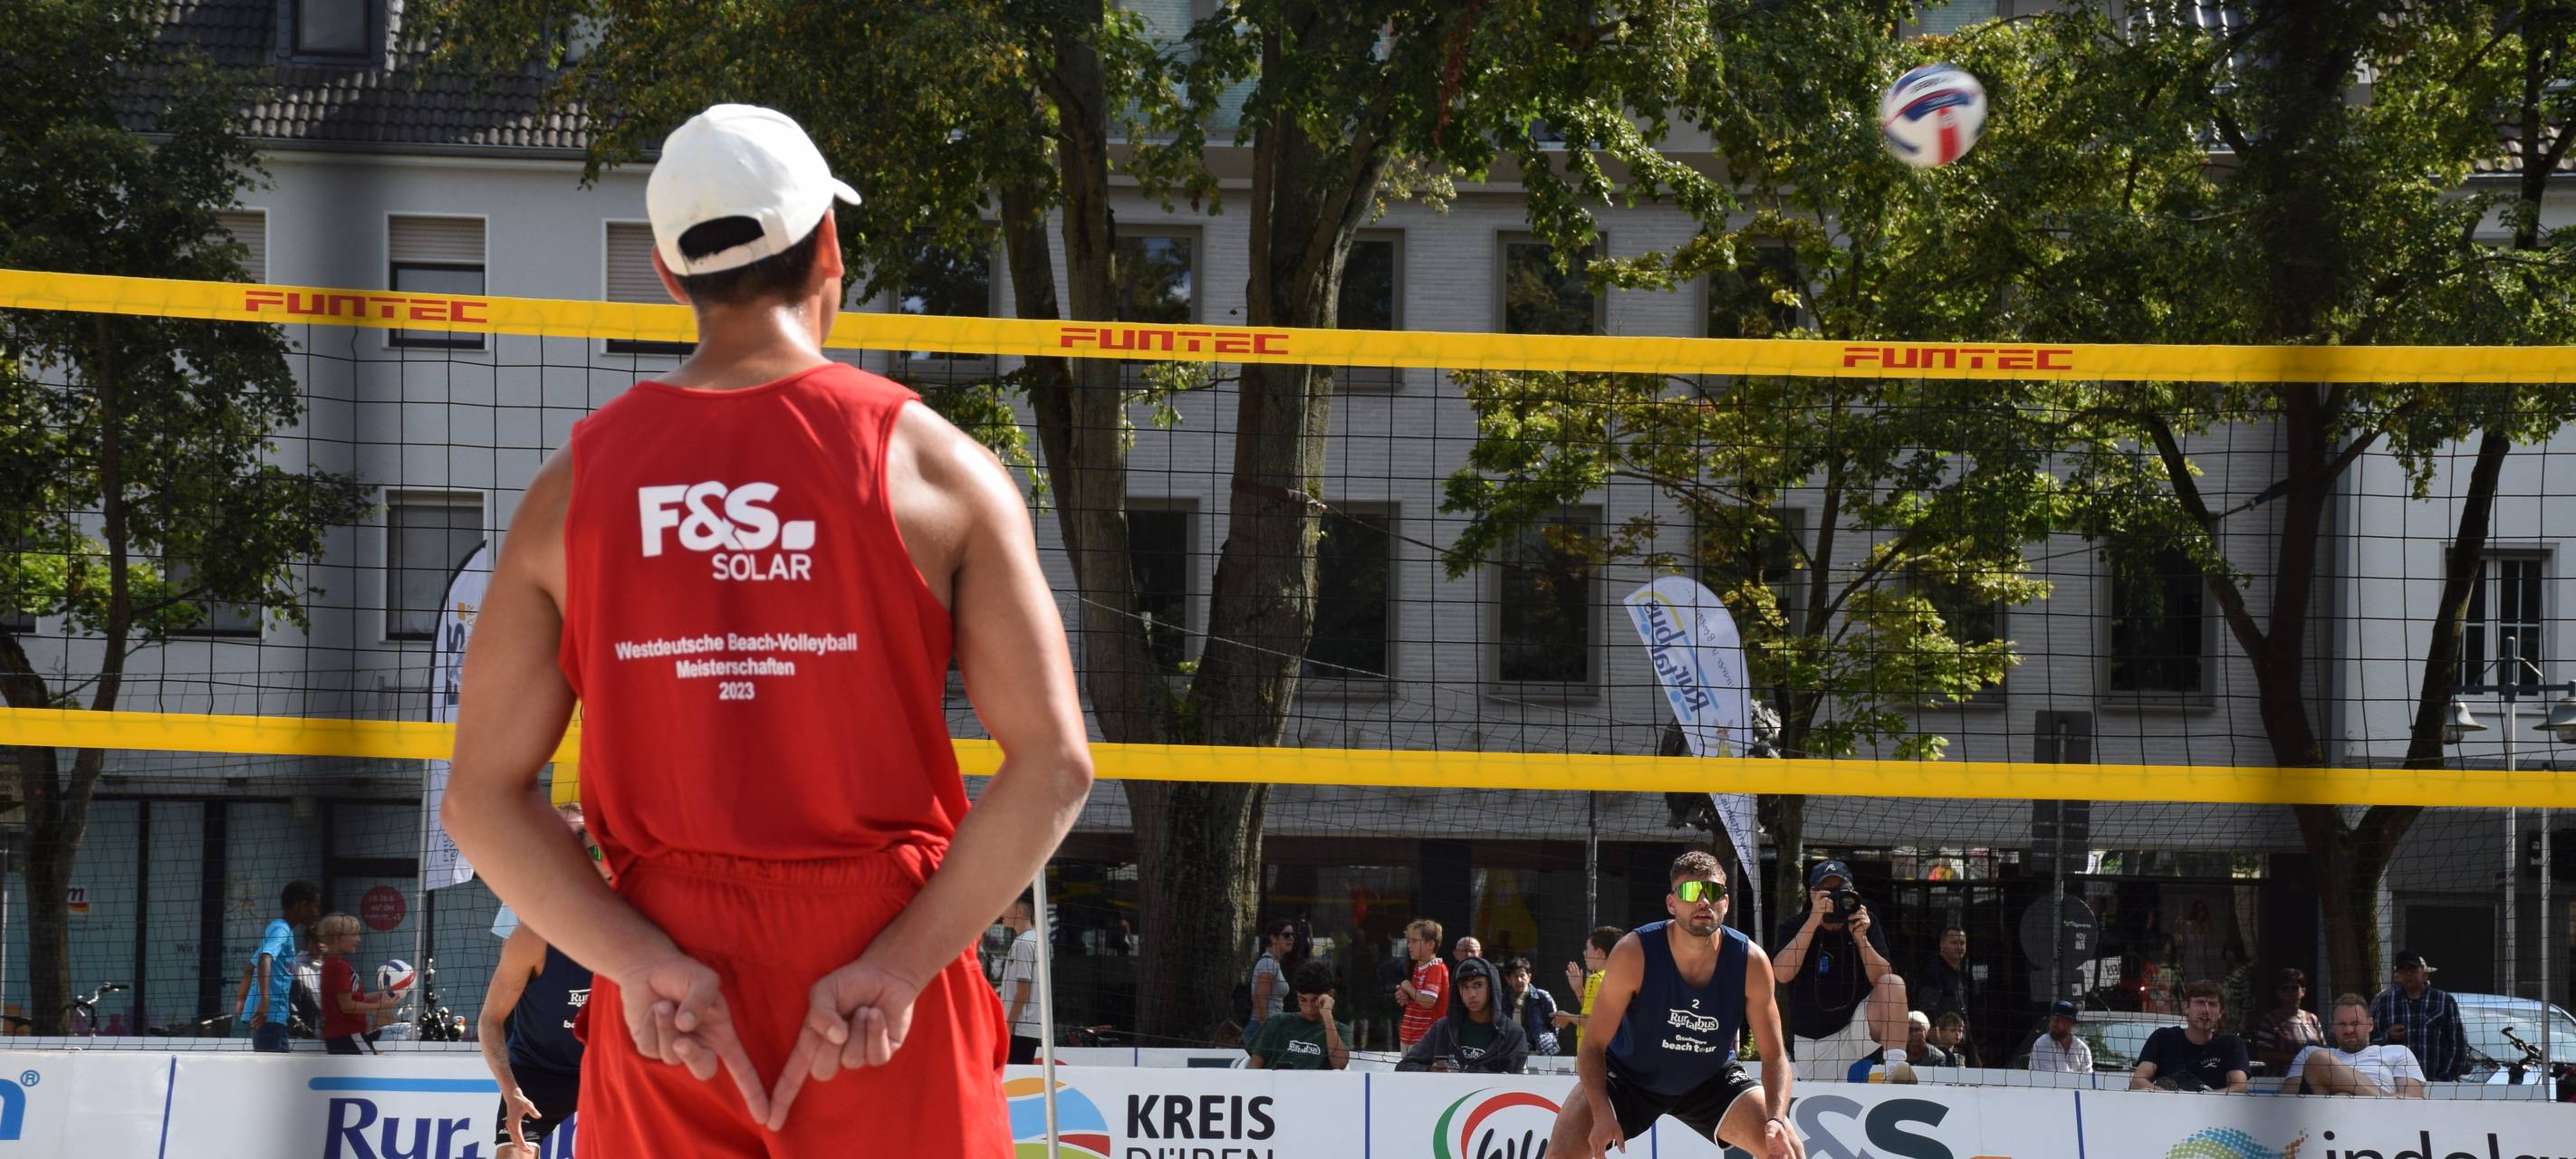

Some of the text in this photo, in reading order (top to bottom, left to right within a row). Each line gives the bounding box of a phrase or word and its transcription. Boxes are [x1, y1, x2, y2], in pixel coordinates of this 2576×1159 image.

[245, 290, 487, 323] FUNTEC
[1061, 327, 1289, 355] FUNTEC
[1843, 347, 2073, 370] FUNTEC
[712, 553, 812, 580] SOLAR
[615, 633, 858, 660] Westdeutsche Beach-Volleyball
[676, 657, 795, 678] Meisterschaften
[719, 682, 755, 700] 2023
[1691, 999, 1700, 1009] 2
[1669, 1011, 1716, 1030] Rurtalbus
[1662, 1039, 1692, 1050] beach
[1127, 1094, 1275, 1140] KREIS
